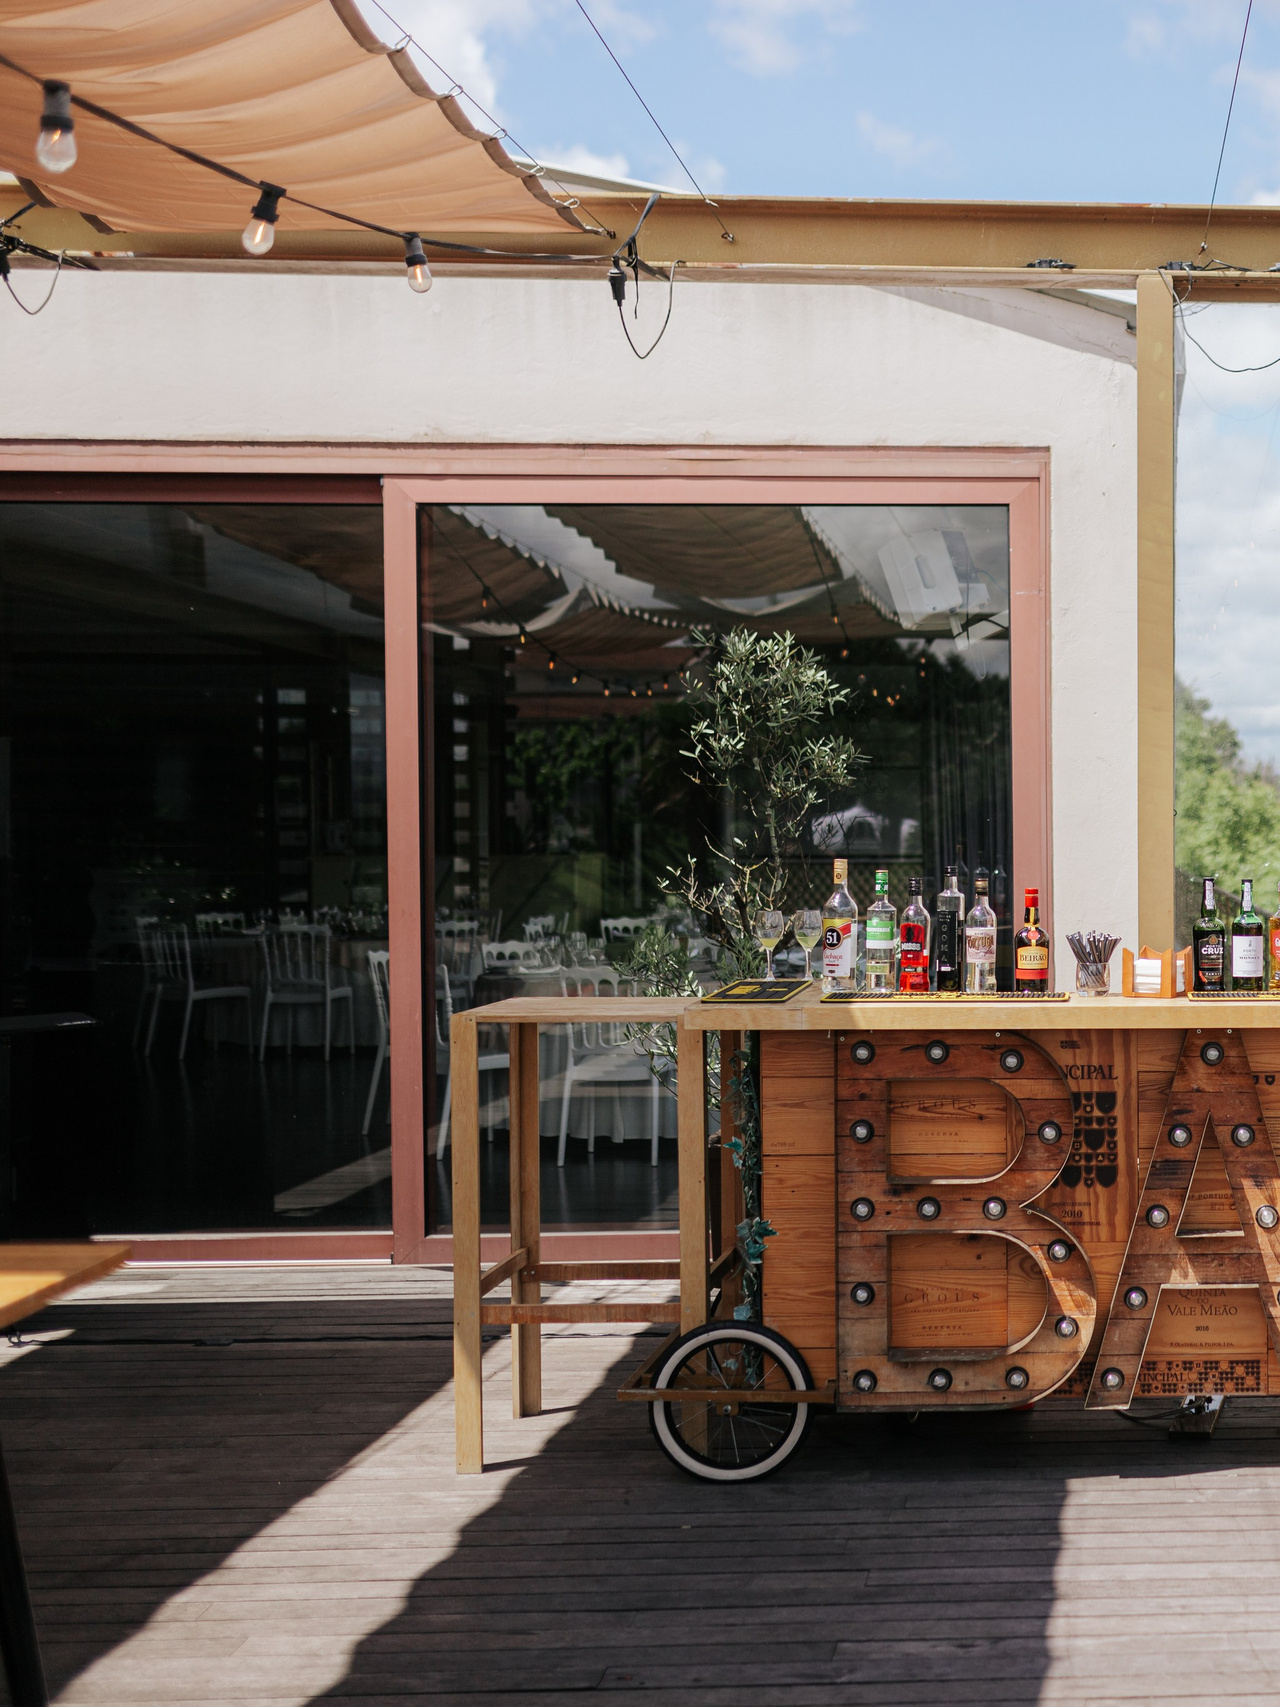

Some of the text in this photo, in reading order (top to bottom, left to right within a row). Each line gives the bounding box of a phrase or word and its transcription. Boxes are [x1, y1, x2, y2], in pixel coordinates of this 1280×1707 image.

[826, 931, 839, 944] 51
[1201, 947, 1224, 955] CRUZ
[1019, 953, 1047, 962] BEIRÃO
[1060, 1064, 1119, 1080] NCIPAL
[1061, 1209, 1083, 1218] 2010
[904, 1292, 980, 1303] GROUS
[1178, 1288, 1227, 1300] QUINTA
[1167, 1303, 1238, 1316] VALE MEÃO
[1137, 1372, 1187, 1383] RINCIPAL
